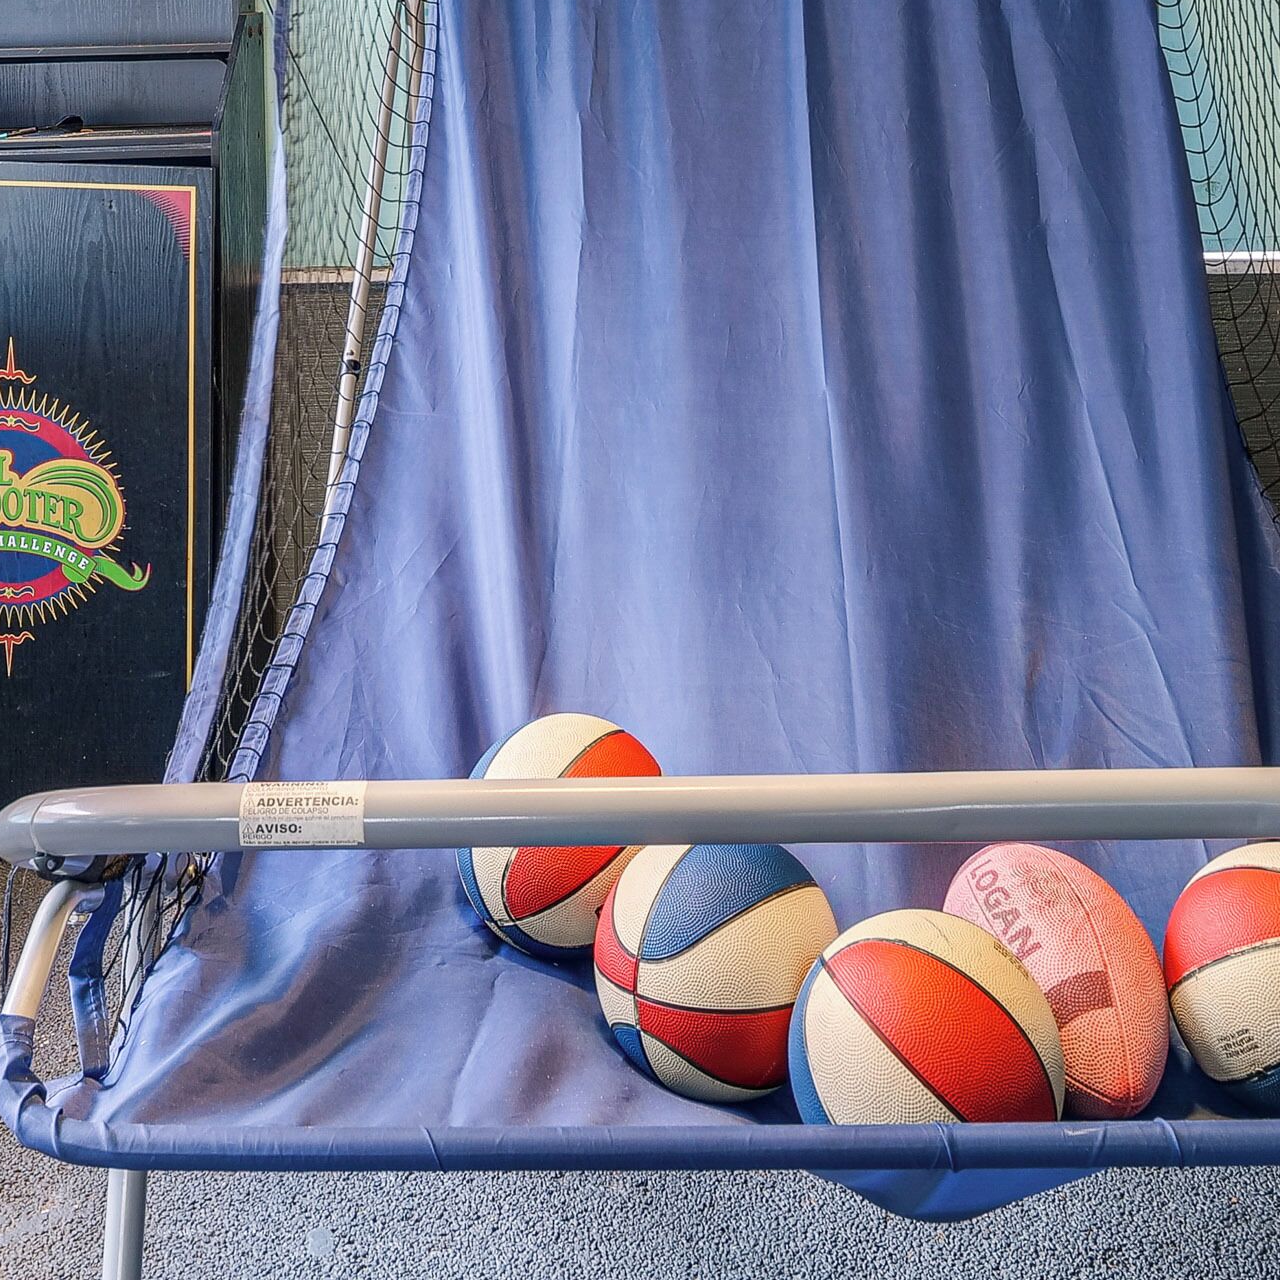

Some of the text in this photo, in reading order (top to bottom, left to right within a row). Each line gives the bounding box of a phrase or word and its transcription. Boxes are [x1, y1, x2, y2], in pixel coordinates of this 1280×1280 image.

[256, 796, 359, 807] ADVERTENCIA:
[255, 824, 302, 833] AVISO:
[970, 860, 1043, 961] LOGAN
